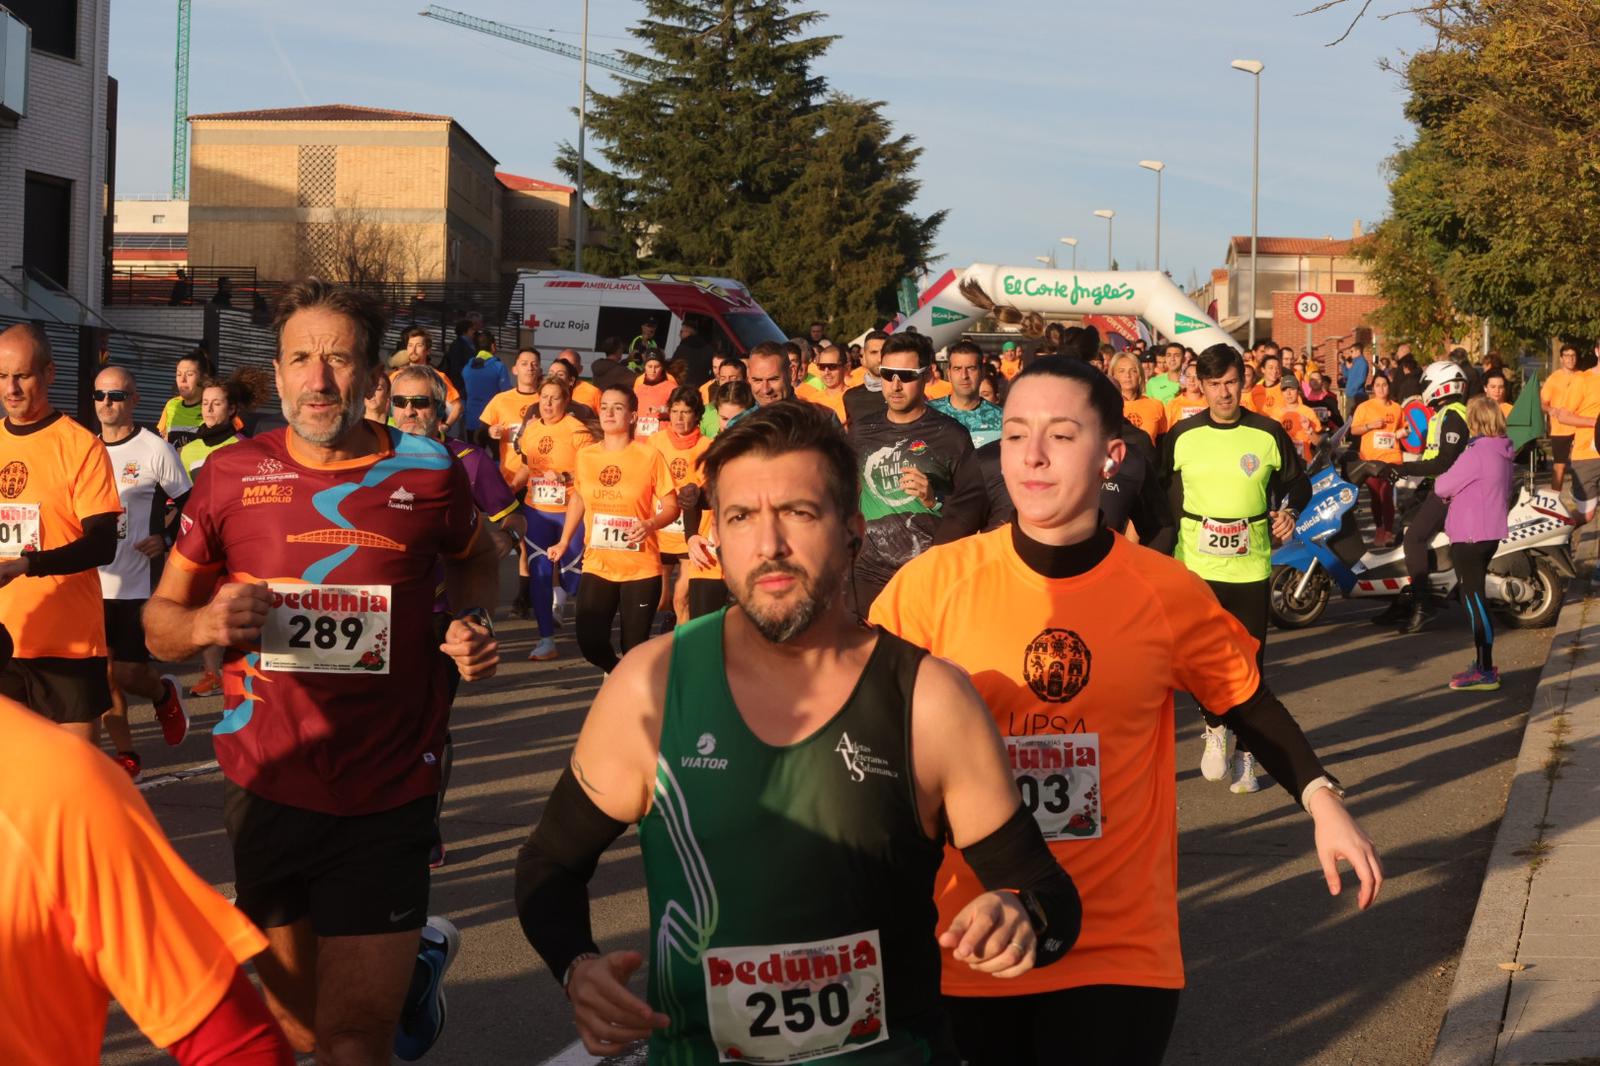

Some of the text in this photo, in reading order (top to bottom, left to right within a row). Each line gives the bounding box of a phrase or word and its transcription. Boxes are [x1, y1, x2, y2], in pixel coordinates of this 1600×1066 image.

[583, 281, 640, 292] AMBULANCIA
[1004, 274, 1135, 306] El Corte Inglés
[1302, 302, 1318, 313] 30
[543, 318, 590, 335] Cruz Roja
[242, 484, 294, 498] MM23
[593, 489, 623, 500] UPSA
[241, 496, 292, 507] VALLADOLID
[1313, 496, 1336, 513] 112
[1534, 494, 1558, 511] 112
[1208, 534, 1240, 549] 205
[288, 615, 364, 650] 289
[1008, 711, 1087, 737] UPSA
[681, 755, 729, 771] VIATOR
[1016, 774, 1071, 814] 03
[707, 939, 877, 987] bedunia
[746, 982, 851, 1037] 250
